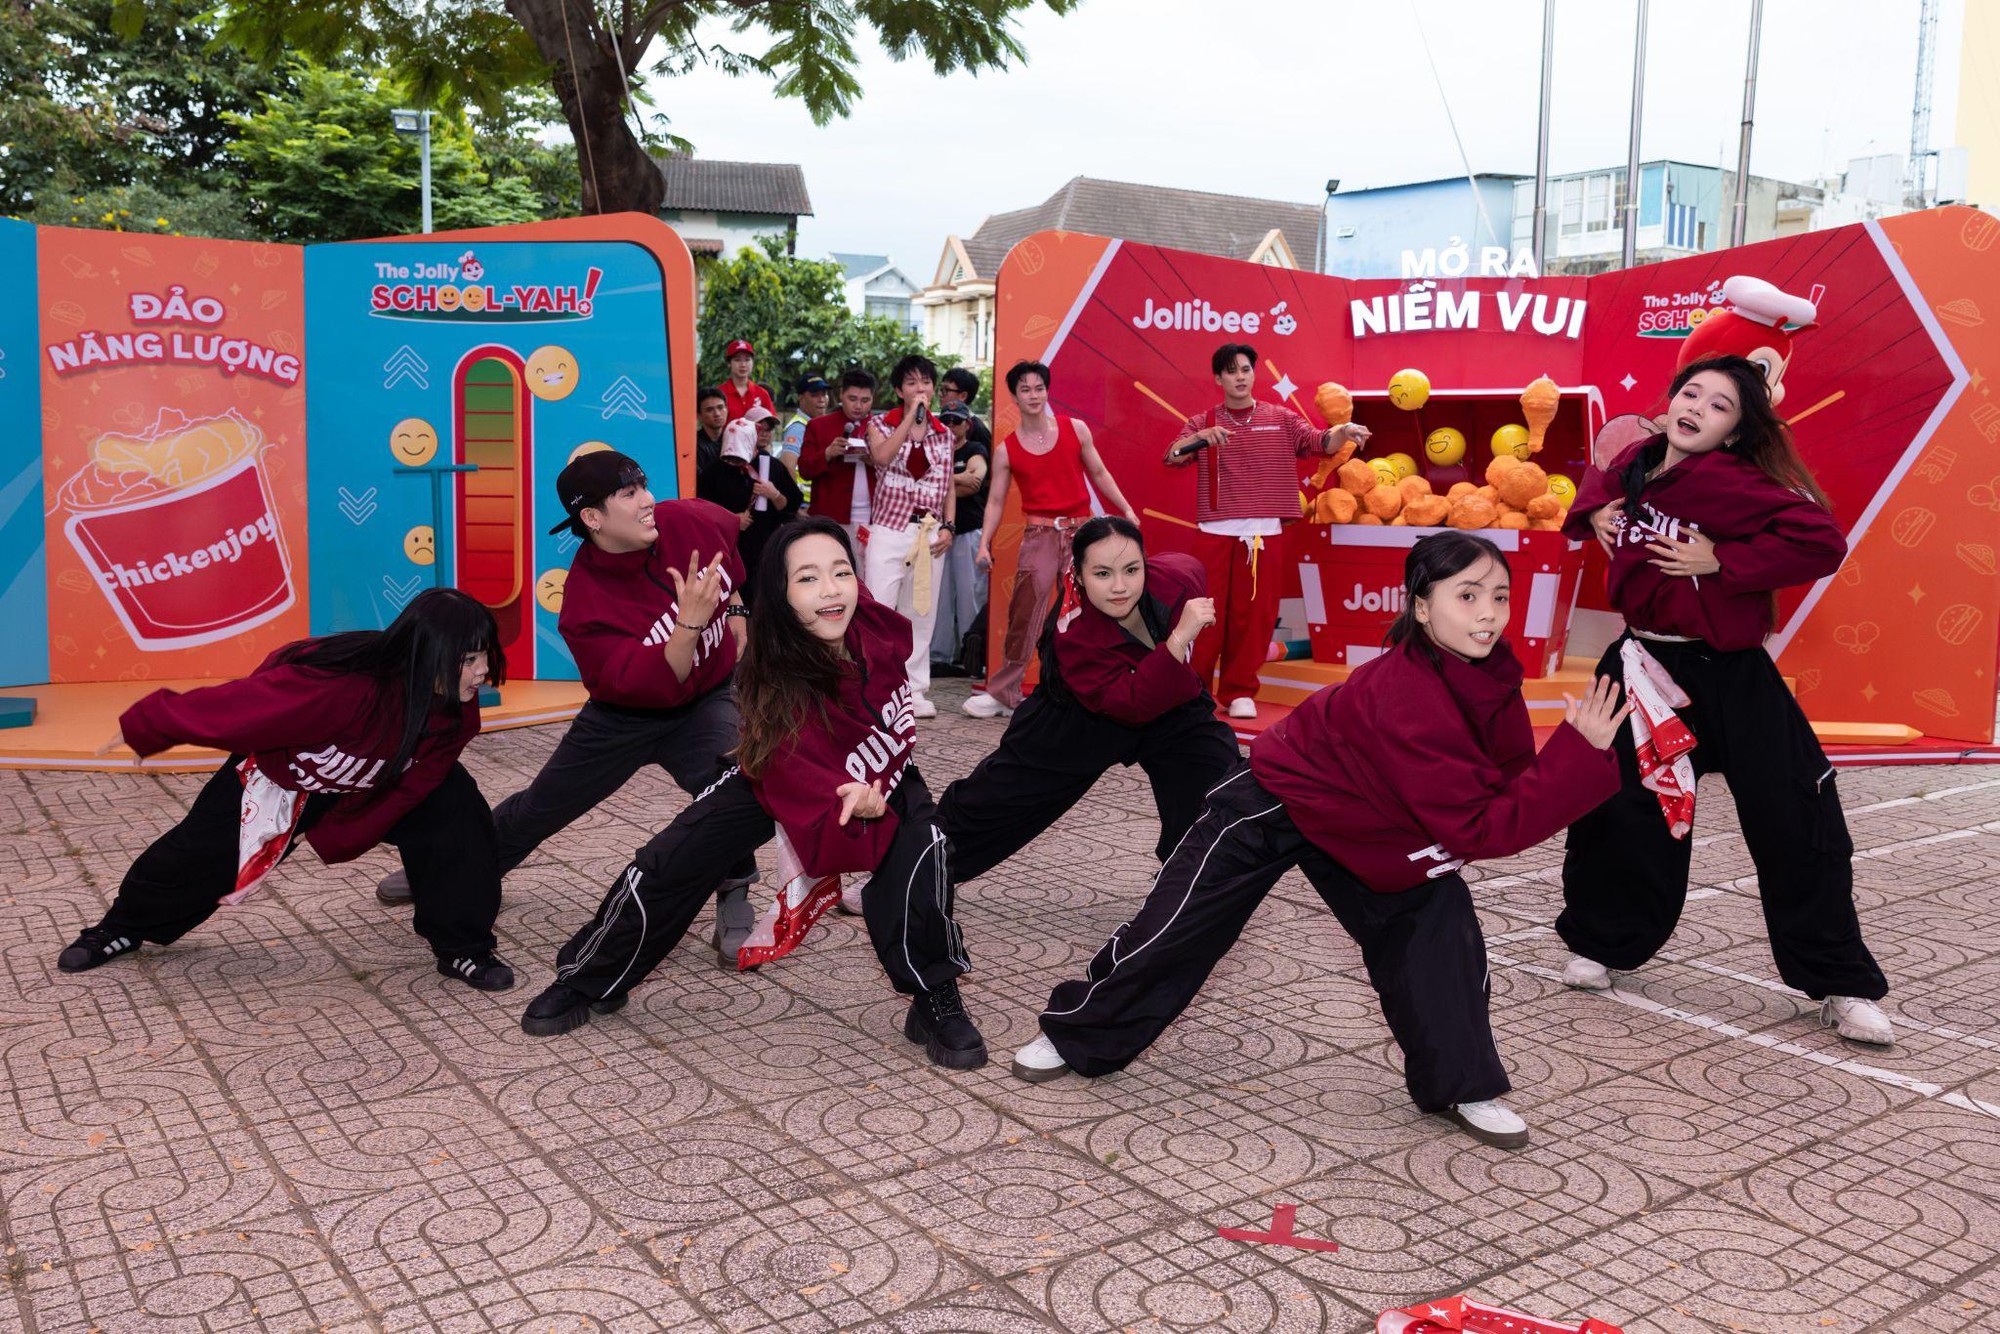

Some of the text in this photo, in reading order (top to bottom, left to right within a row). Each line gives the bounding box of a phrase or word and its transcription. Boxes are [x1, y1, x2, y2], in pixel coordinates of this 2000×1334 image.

[375, 262, 459, 282] The Jolly
[1401, 235, 1538, 279] MỞ RA
[131, 286, 224, 323] ĐẢO
[1132, 298, 1261, 335] Jollibee
[1351, 279, 1587, 339] NIỀM VUI
[1643, 292, 1707, 308] The Jolly
[49, 332, 300, 381] NĂNG LƯỢNG
